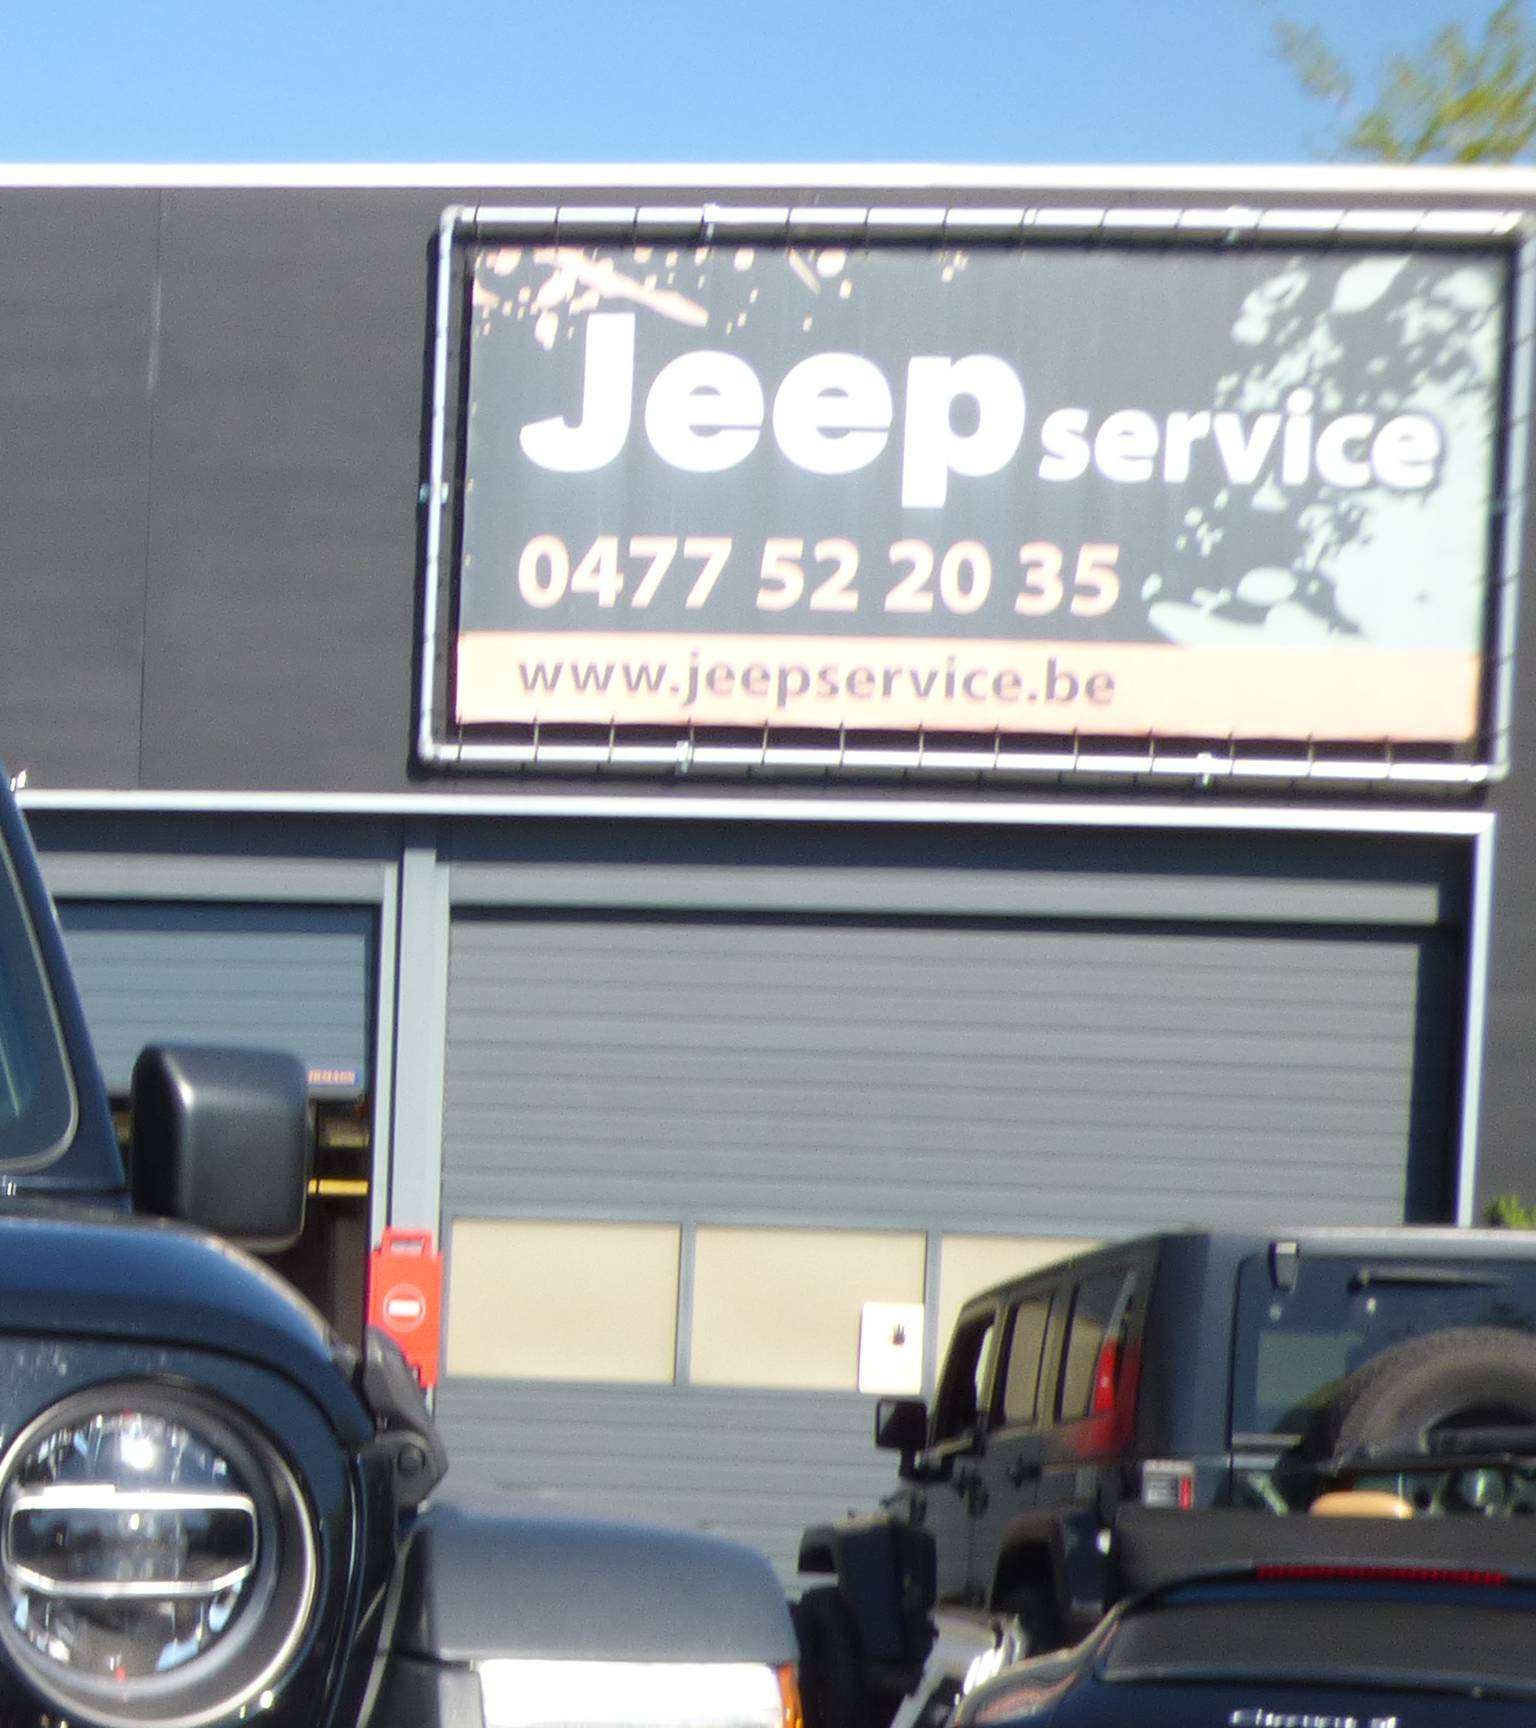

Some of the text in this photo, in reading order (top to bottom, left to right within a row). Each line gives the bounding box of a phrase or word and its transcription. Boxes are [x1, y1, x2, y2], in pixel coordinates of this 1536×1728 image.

[519, 311, 1444, 509] Jeep service
[516, 535, 1121, 617] 0477 52 20 35
[518, 650, 1118, 706] www.jeepservice.be
